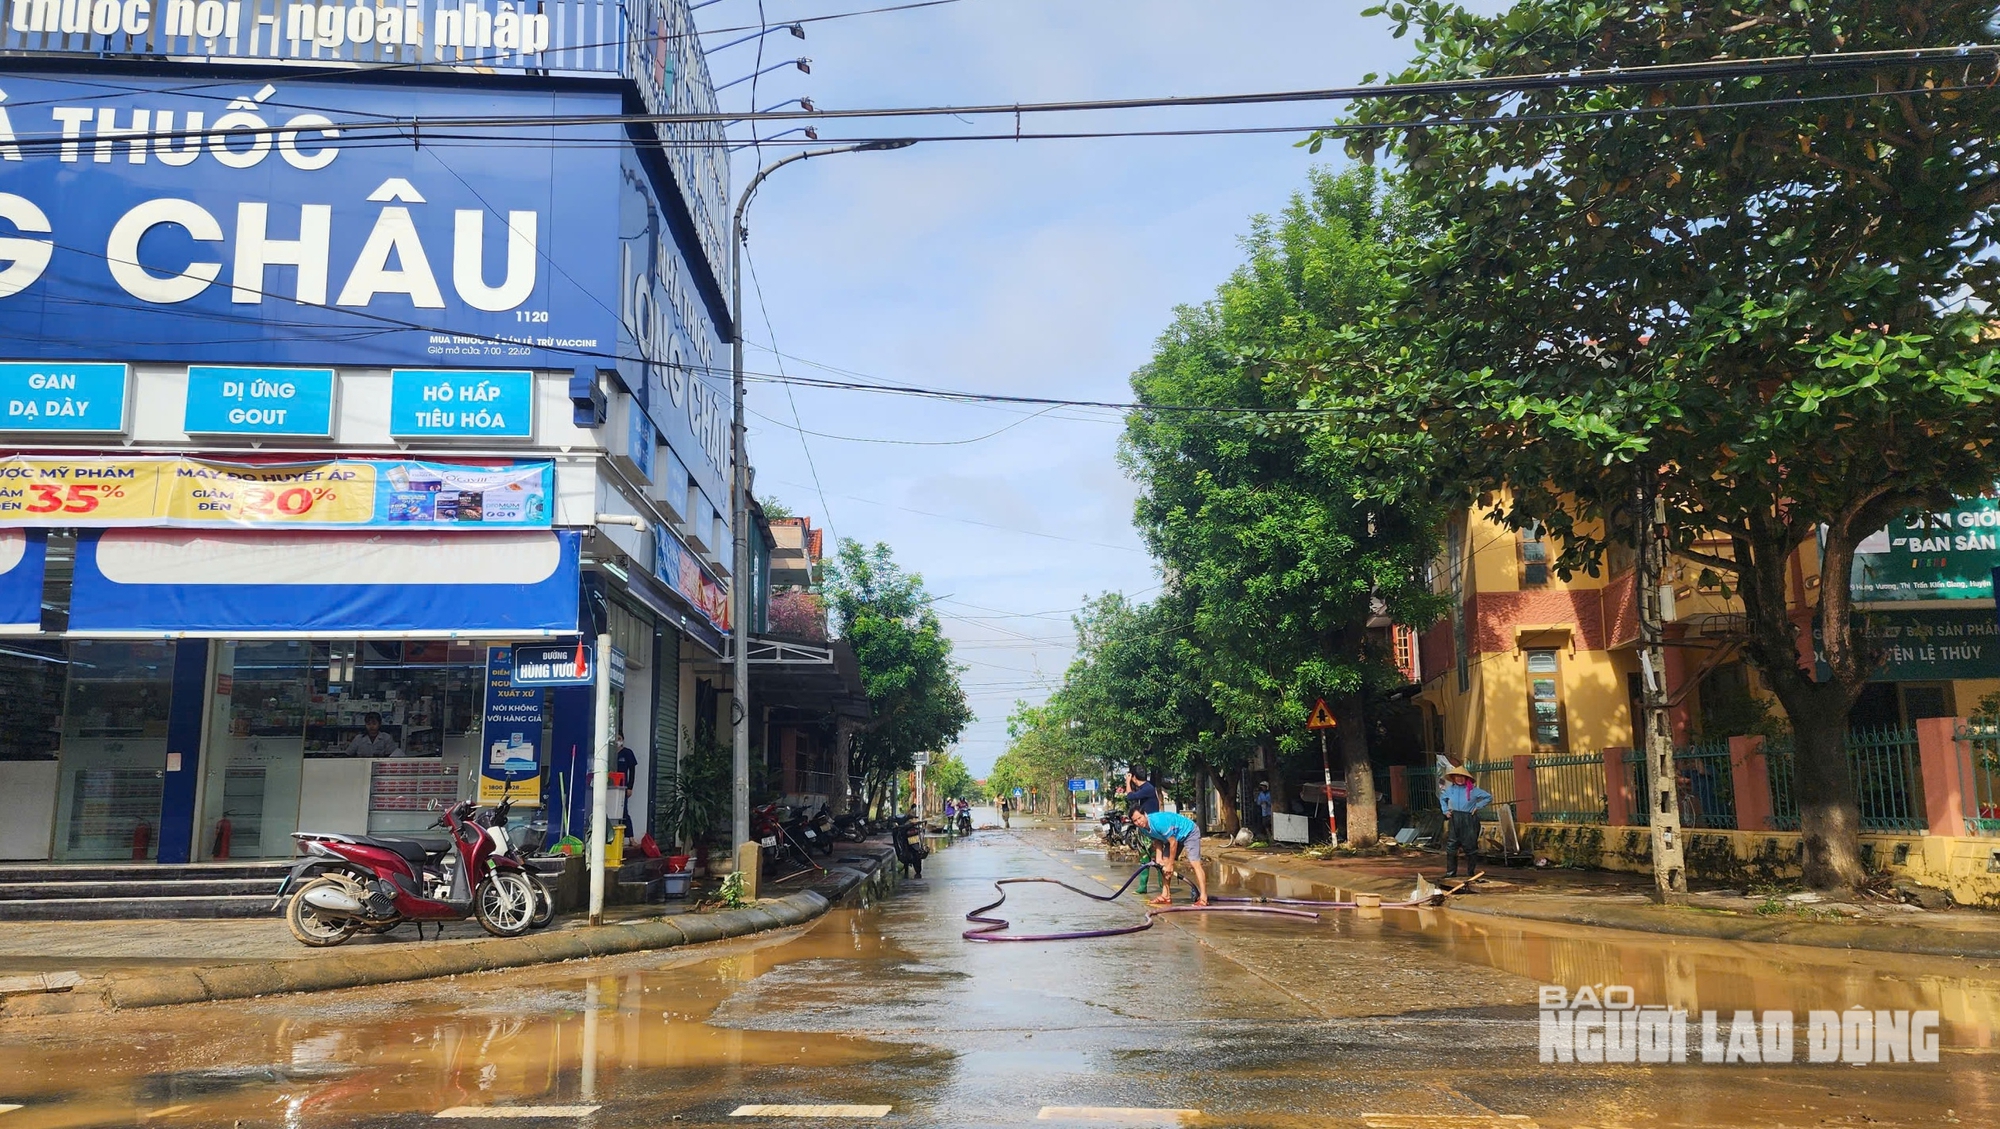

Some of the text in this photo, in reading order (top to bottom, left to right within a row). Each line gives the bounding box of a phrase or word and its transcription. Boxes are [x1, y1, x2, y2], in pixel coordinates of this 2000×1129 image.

[434, 3, 549, 59] nhập
[52, 84, 340, 170] THUỐC
[107, 178, 537, 312] CHÂU
[516, 311, 548, 322] 1120
[430, 335, 450, 344] MUA
[536, 336, 554, 347] TRỪ
[556, 339, 597, 347] VACCINE
[445, 346, 460, 354] mở
[620, 241, 728, 484] LONG CHÂU
[28, 373, 76, 390] GAN
[223, 378, 296, 401] DỊ ỨNG
[423, 380, 501, 402] HÔ HẤP
[9, 397, 90, 420] DẠ DÀY
[228, 408, 287, 424] GOUT
[415, 408, 506, 428] TIÊU HÓA
[40, 466, 70, 478] MỸ
[75, 465, 135, 478] PHẨM
[328, 469, 356, 481] ÁP
[0, 487, 23, 498] ẢM
[192, 488, 234, 500] GIẢM
[0, 500, 21, 510] ẾN
[198, 500, 231, 511] ĐẾN
[1955, 530, 1996, 551] SẢN
[1937, 621, 1964, 636] SẢN
[542, 650, 568, 660] ĐƯỜNG
[1920, 644, 1936, 664] LỆ
[1940, 641, 1981, 660] THỦY
[520, 661, 549, 678] HÙNG
[498, 689, 535, 697] XUẤT XỨ
[487, 714, 542, 722] VỚI HÀNG GIẢ
